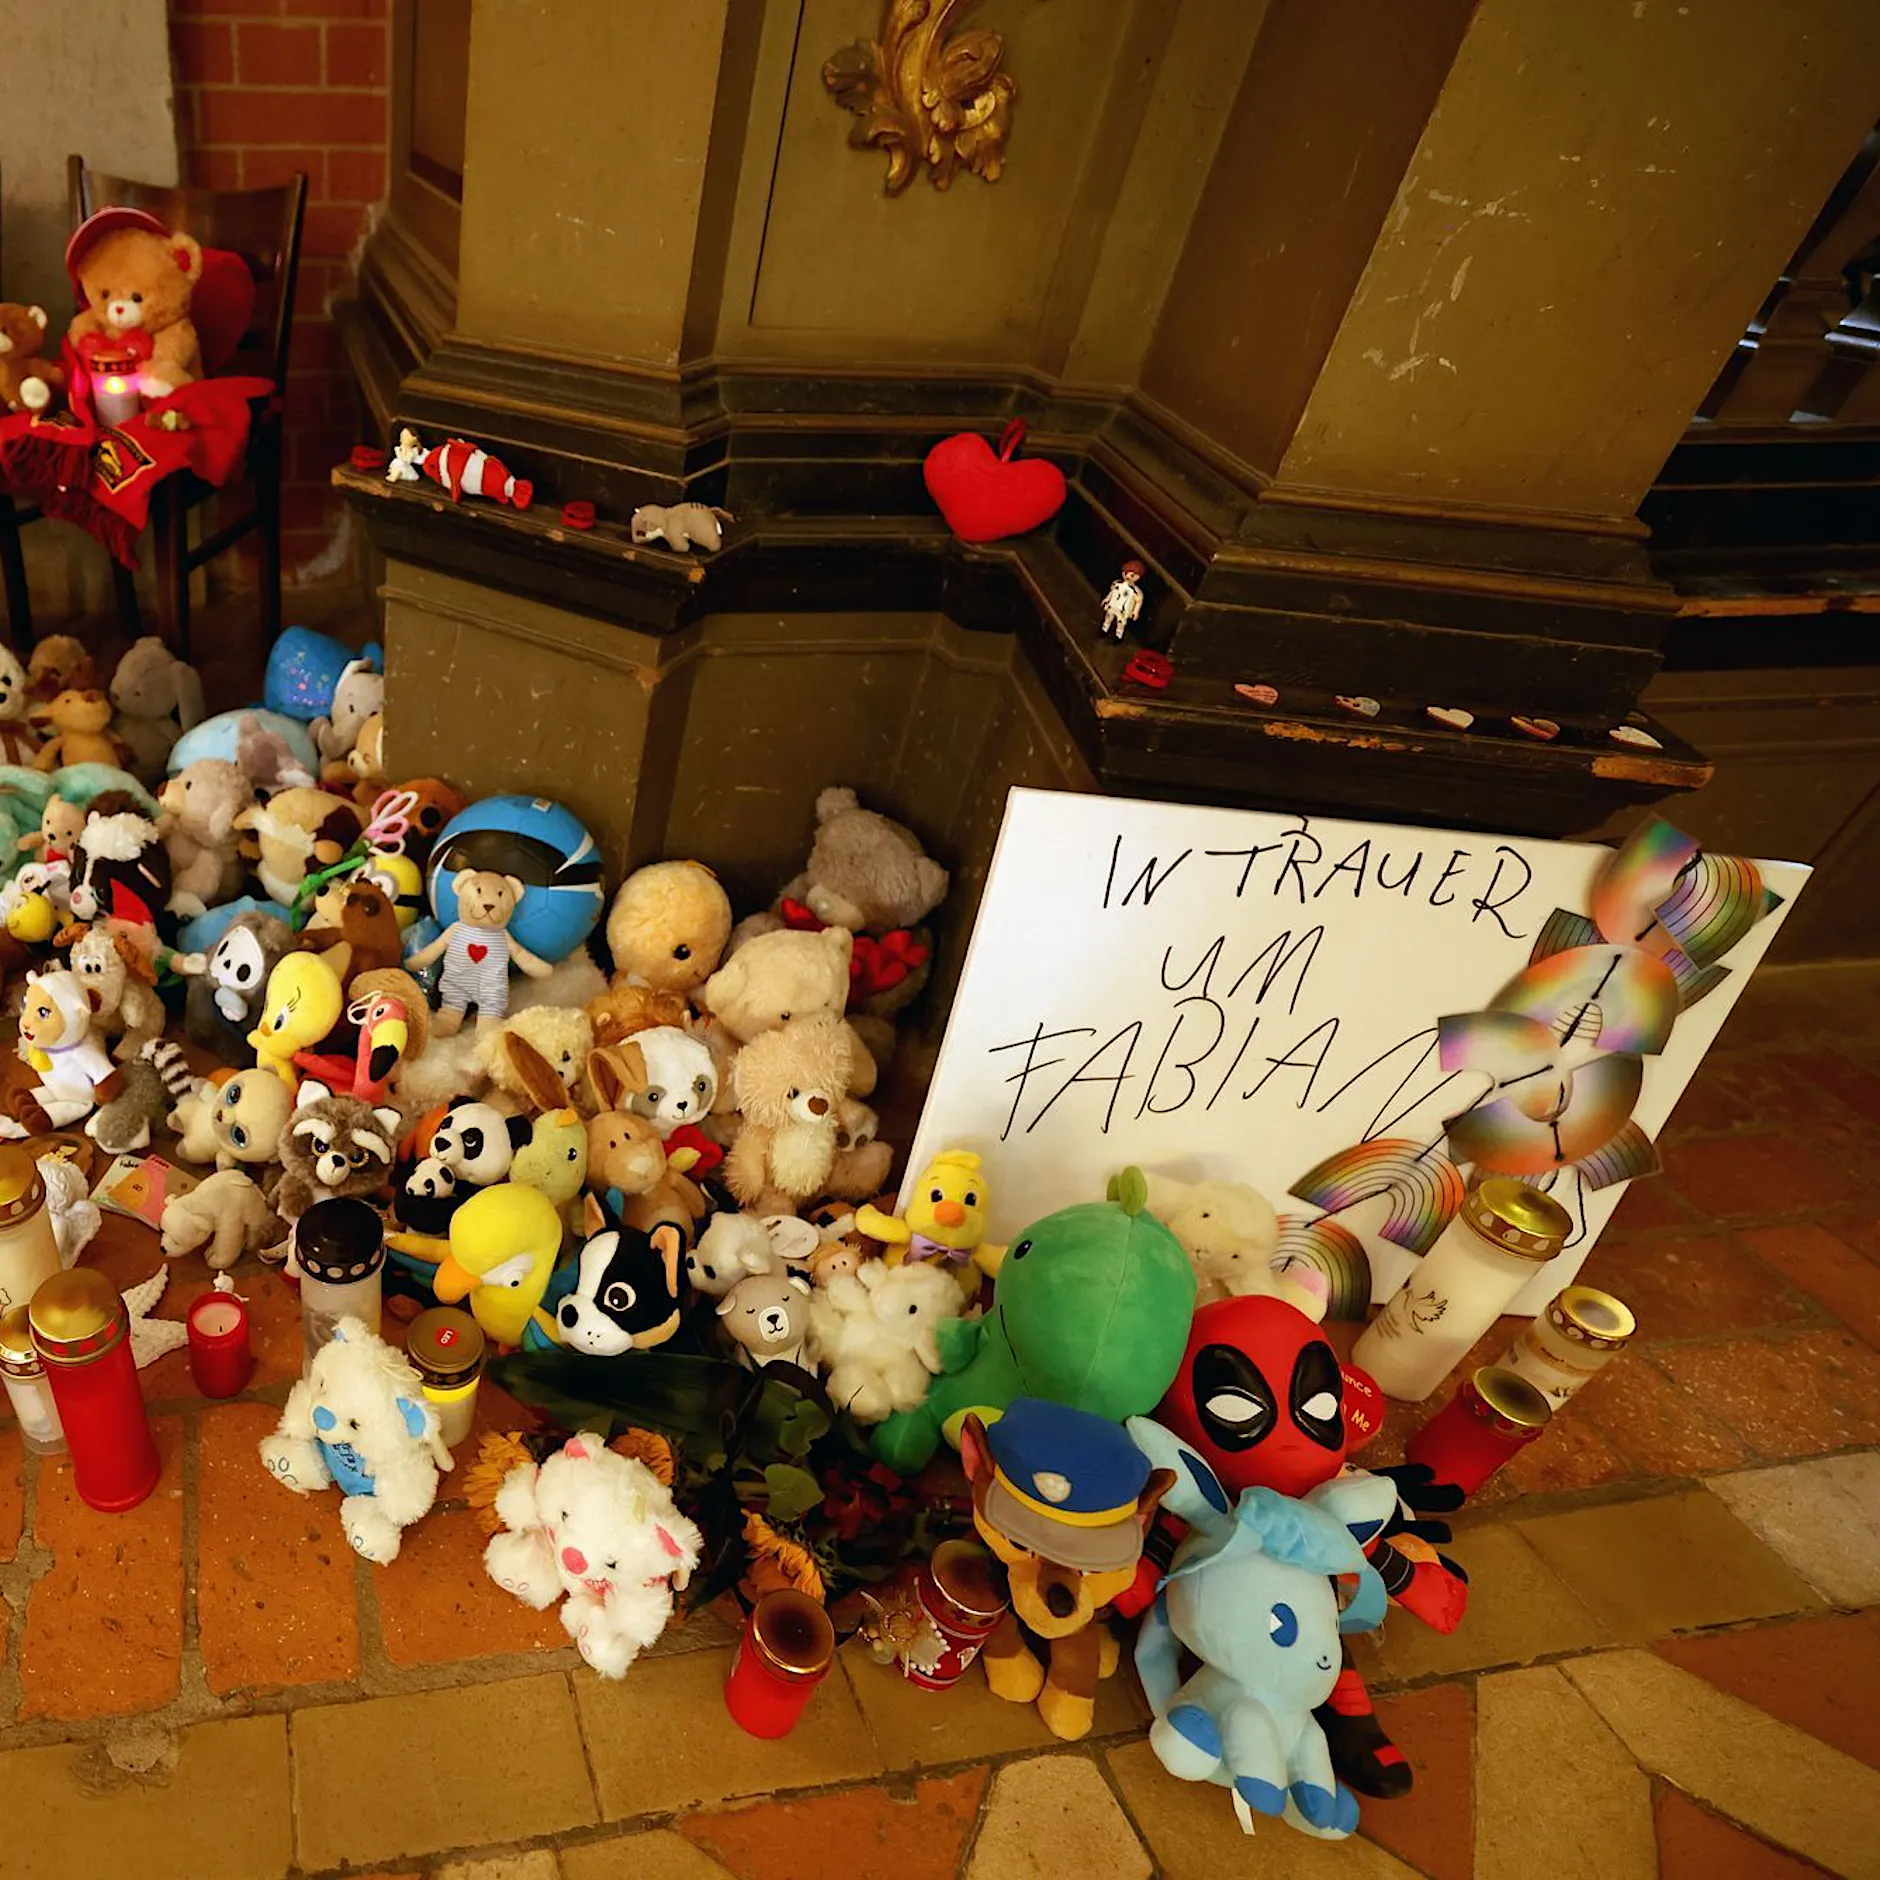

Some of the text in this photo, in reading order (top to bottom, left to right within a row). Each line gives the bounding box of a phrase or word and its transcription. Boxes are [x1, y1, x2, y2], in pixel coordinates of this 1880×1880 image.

[1103, 816, 1532, 938] IN TRAUER
[1161, 925, 1325, 1015] UM
[988, 997, 1463, 1143] FABIAN
[1351, 1409, 1371, 1433] Me
